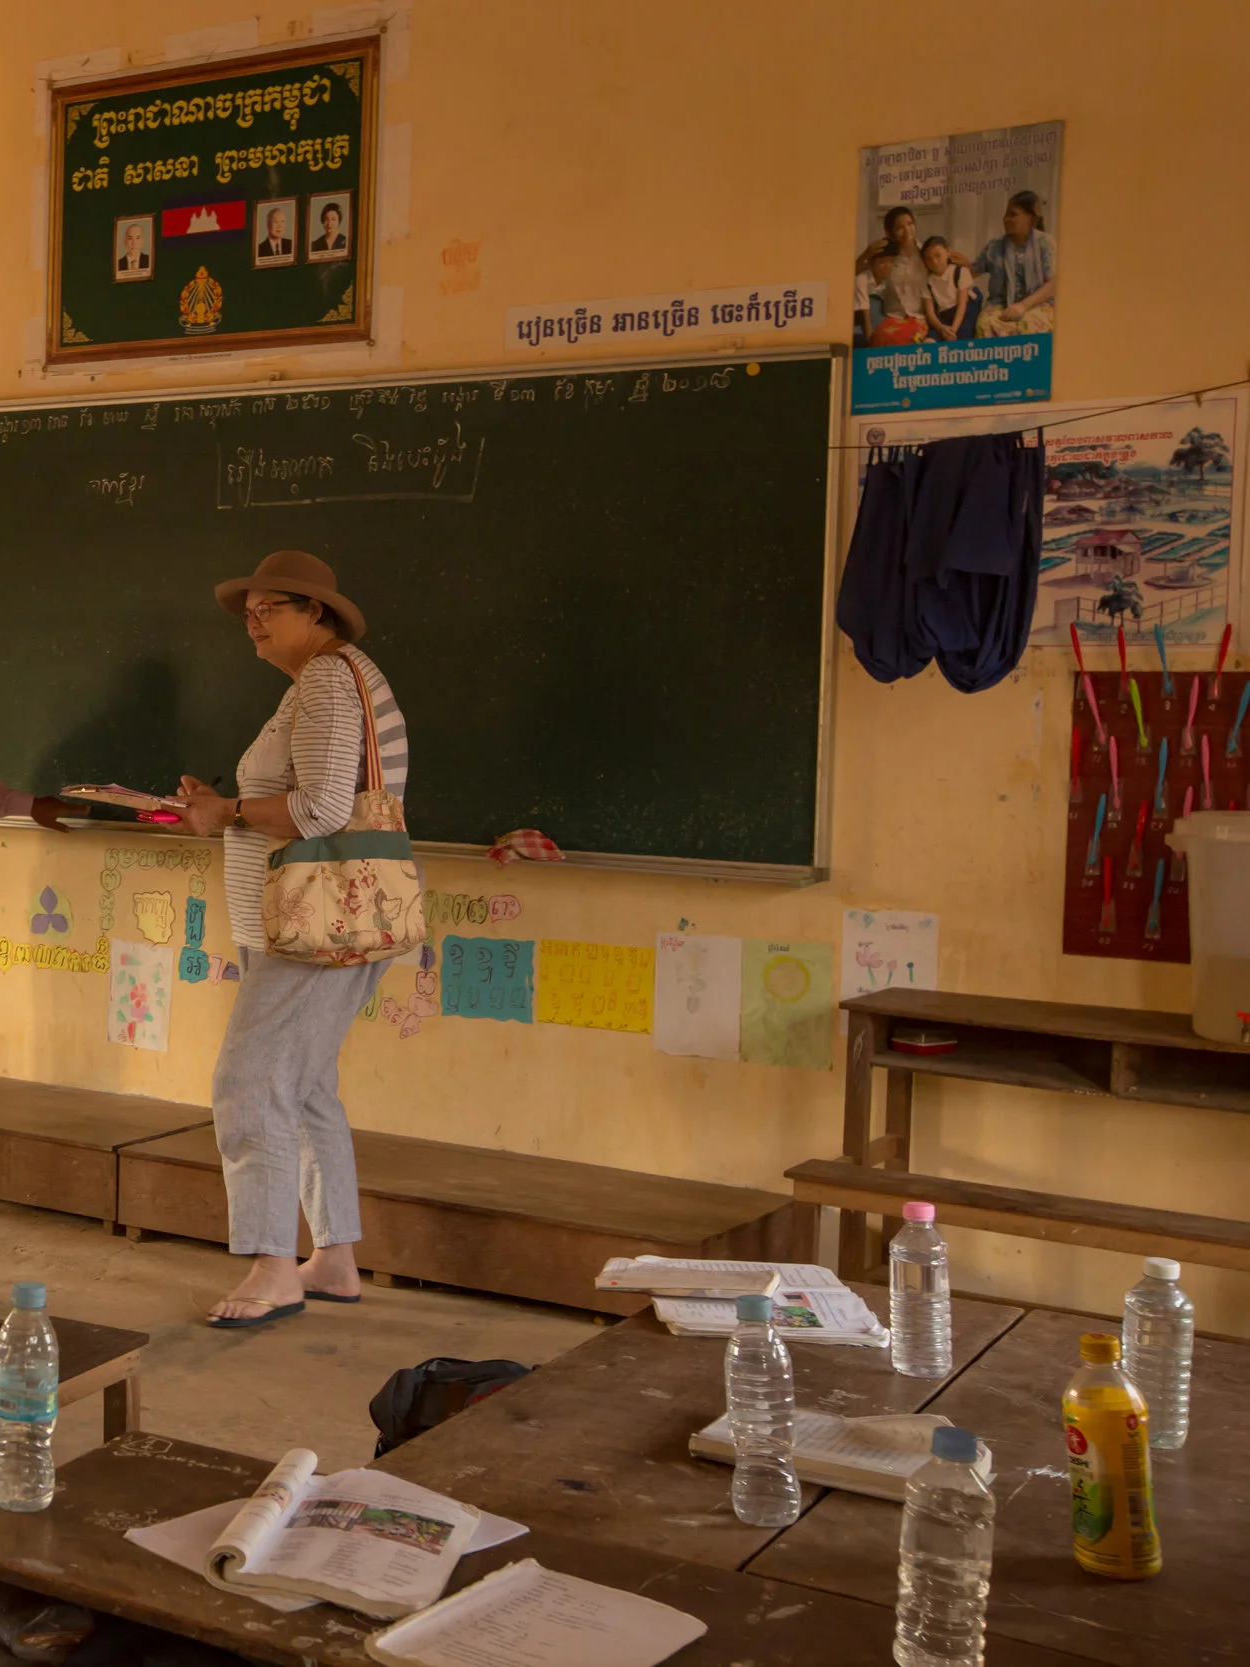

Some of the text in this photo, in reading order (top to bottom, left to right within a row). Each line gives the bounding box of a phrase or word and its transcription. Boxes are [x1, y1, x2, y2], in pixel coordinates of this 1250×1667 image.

[92, 75, 332, 149] ព្រះរាជាណាចក្រកម្ពុជា
[71, 134, 350, 192] ជាតិ សាសនា ព្រះមហាក្សត្រ
[517, 307, 602, 346] រៀនច្រើន
[612, 300, 700, 337] អានច្រើន
